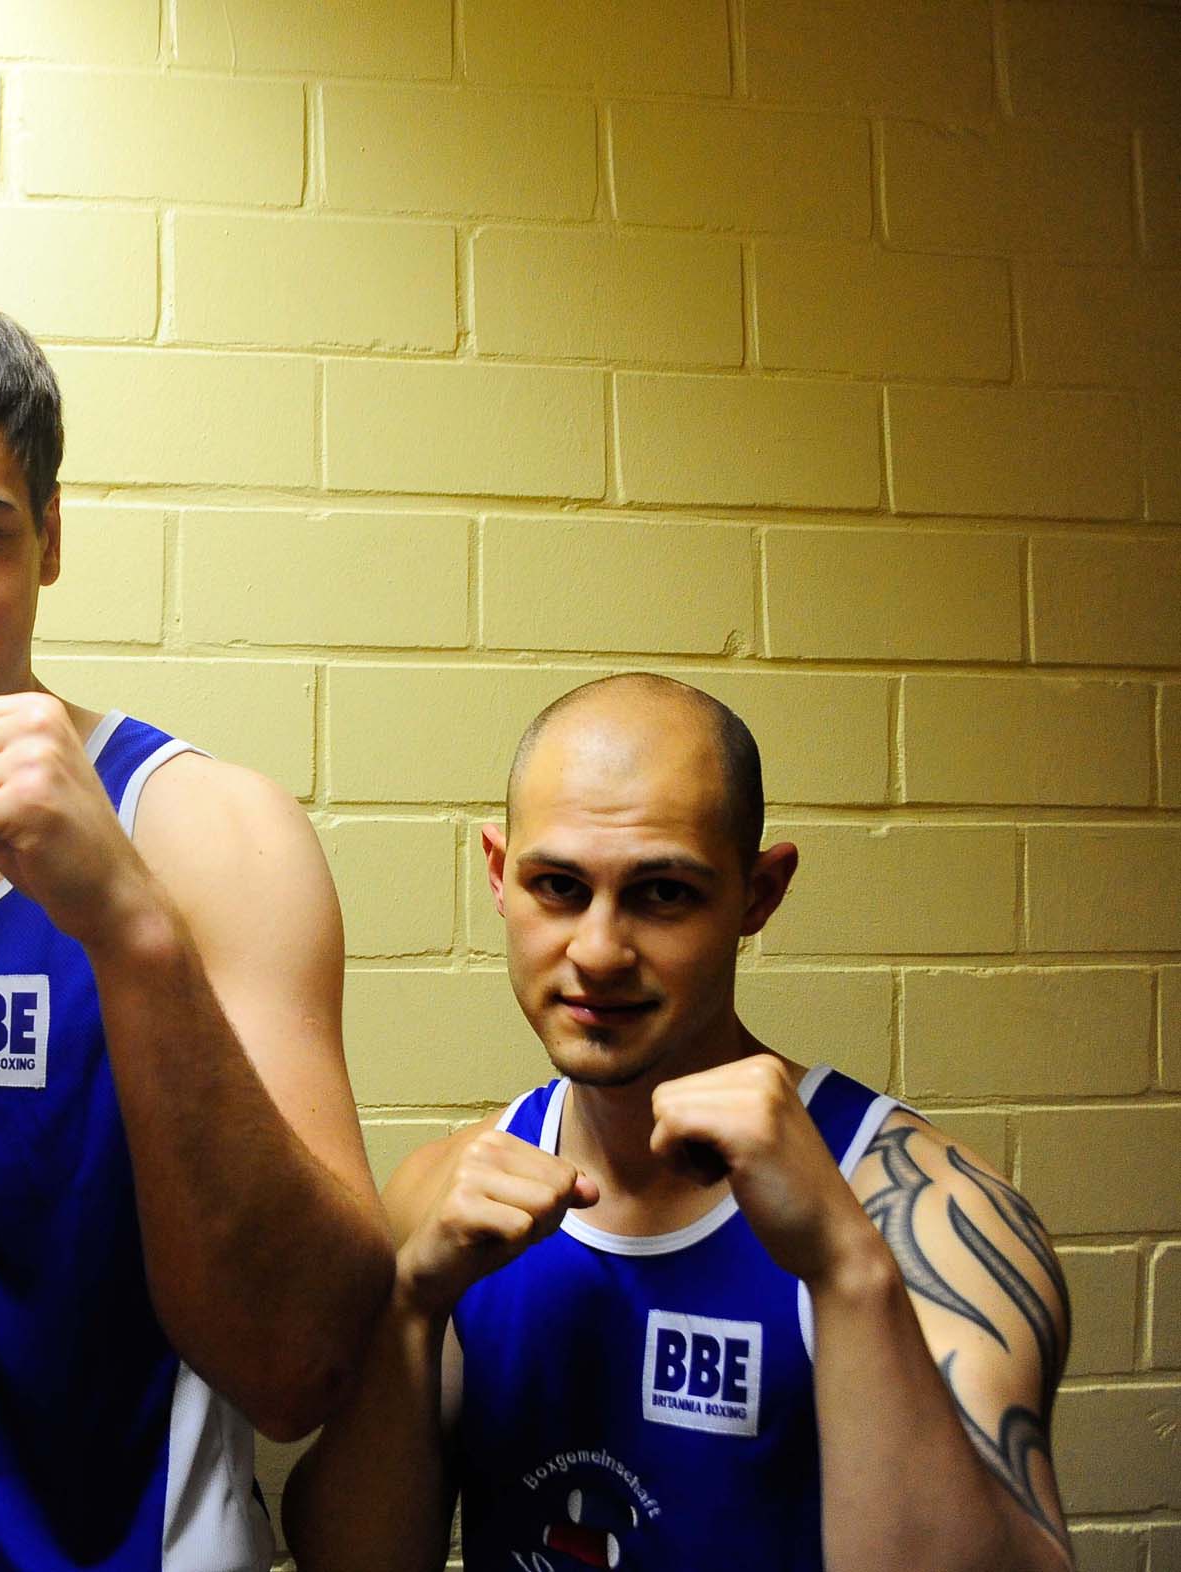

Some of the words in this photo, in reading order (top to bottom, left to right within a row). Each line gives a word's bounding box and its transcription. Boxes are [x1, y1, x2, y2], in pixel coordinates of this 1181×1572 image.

[653, 1327, 750, 1404] BBE
[651, 1393, 702, 1414] BRITANNIA
[704, 1402, 748, 1420] BOXING
[522, 1449, 663, 1520] Boxgemeinschaft
